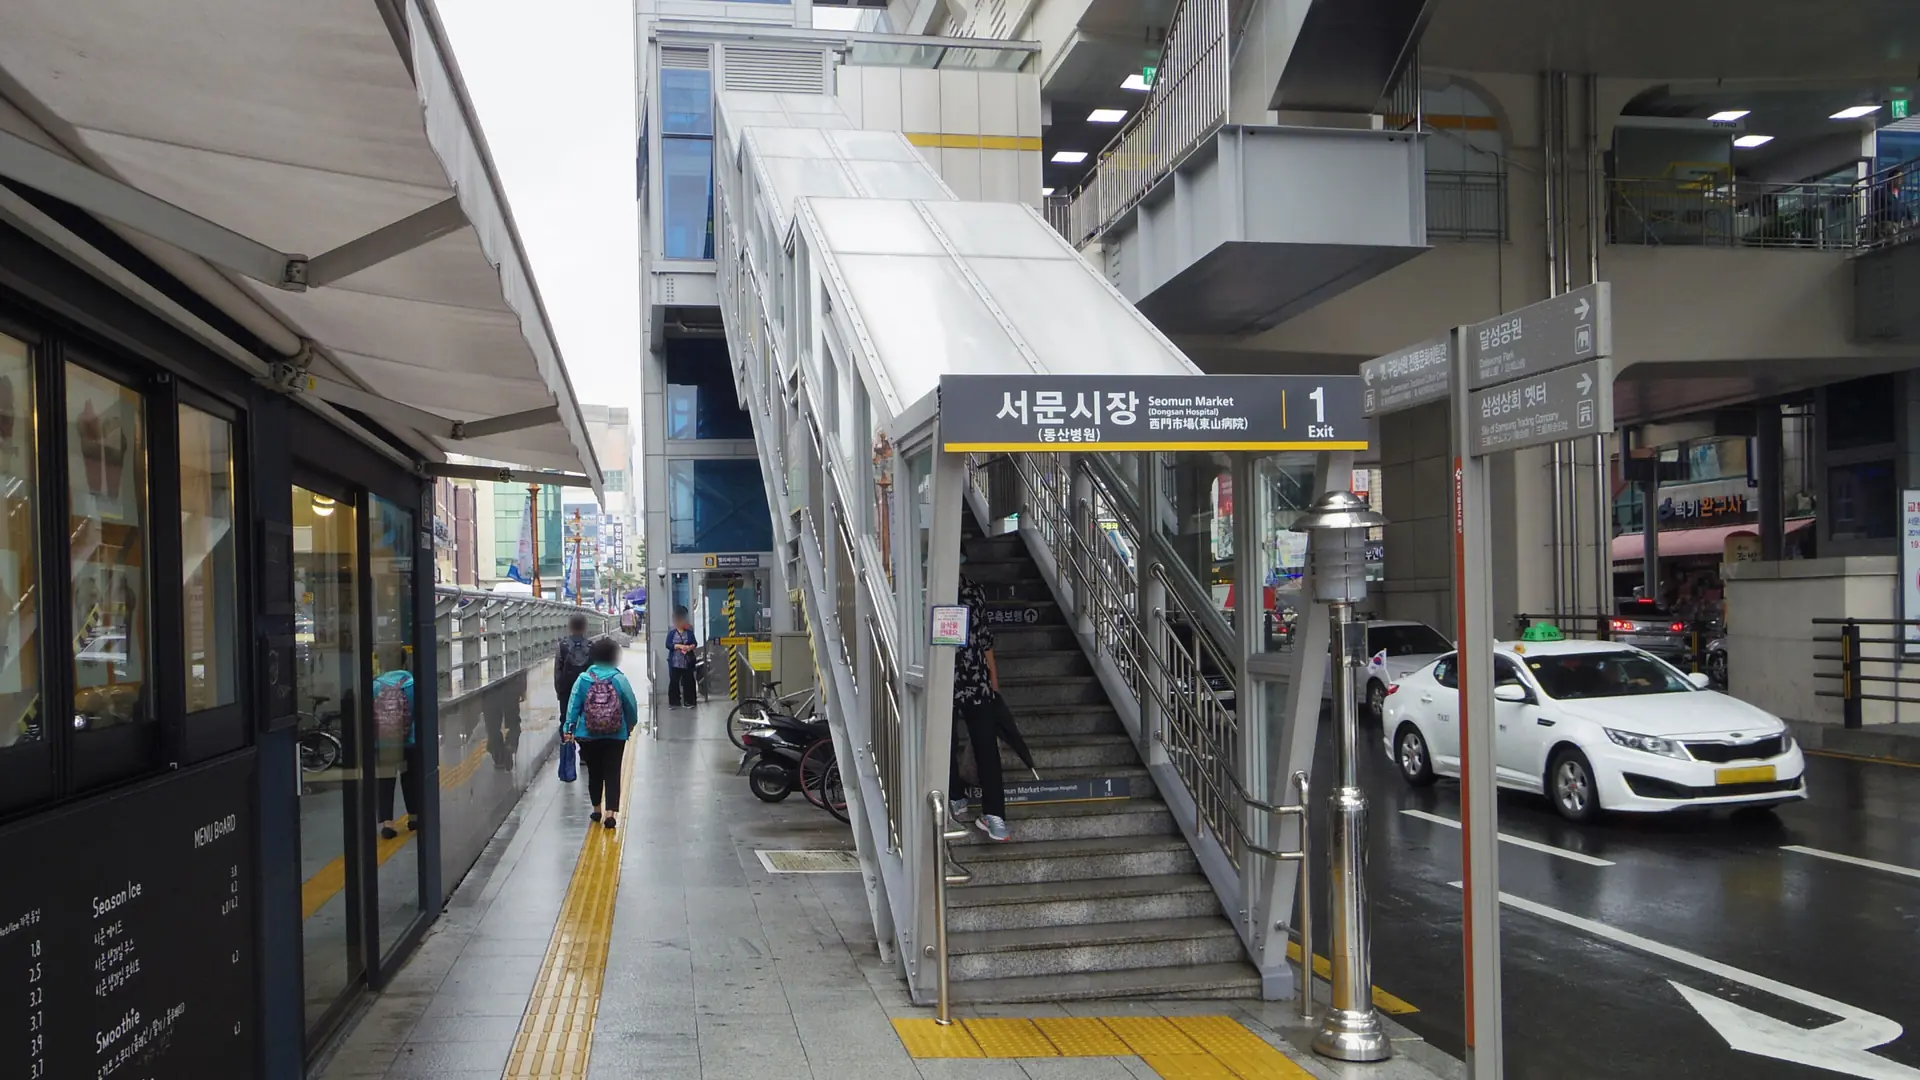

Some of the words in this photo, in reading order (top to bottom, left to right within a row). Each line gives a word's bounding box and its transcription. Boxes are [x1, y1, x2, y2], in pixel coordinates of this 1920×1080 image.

[1480, 317, 1522, 351] 달성공원
[996, 390, 1140, 426] 서문시장
[1148, 395, 1192, 407] Seomun
[1196, 395, 1234, 407] Market
[1309, 387, 1324, 423] 1
[1481, 388, 1521, 418] 삼성상회
[1525, 382, 1546, 408] 옛터
[1148, 408, 1184, 416] (Dongsan
[1186, 408, 1219, 416] Hospital)
[1149, 417, 1249, 430] 西門市場(東山病院)
[1308, 425, 1334, 438] Exit
[1038, 427, 1101, 443] (동산병원)
[986, 610, 1023, 623] 우측보행
[1017, 786, 1040, 794] Market
[1104, 779, 1112, 791] 1
[194, 824, 213, 848] MENU
[92, 891, 127, 918] Season
[128, 880, 142, 899] Ice
[31, 939, 41, 958] 1.8
[29, 962, 41, 983] 2.5
[30, 987, 42, 1007] 3.2
[31, 1034, 43, 1057] 3.9
